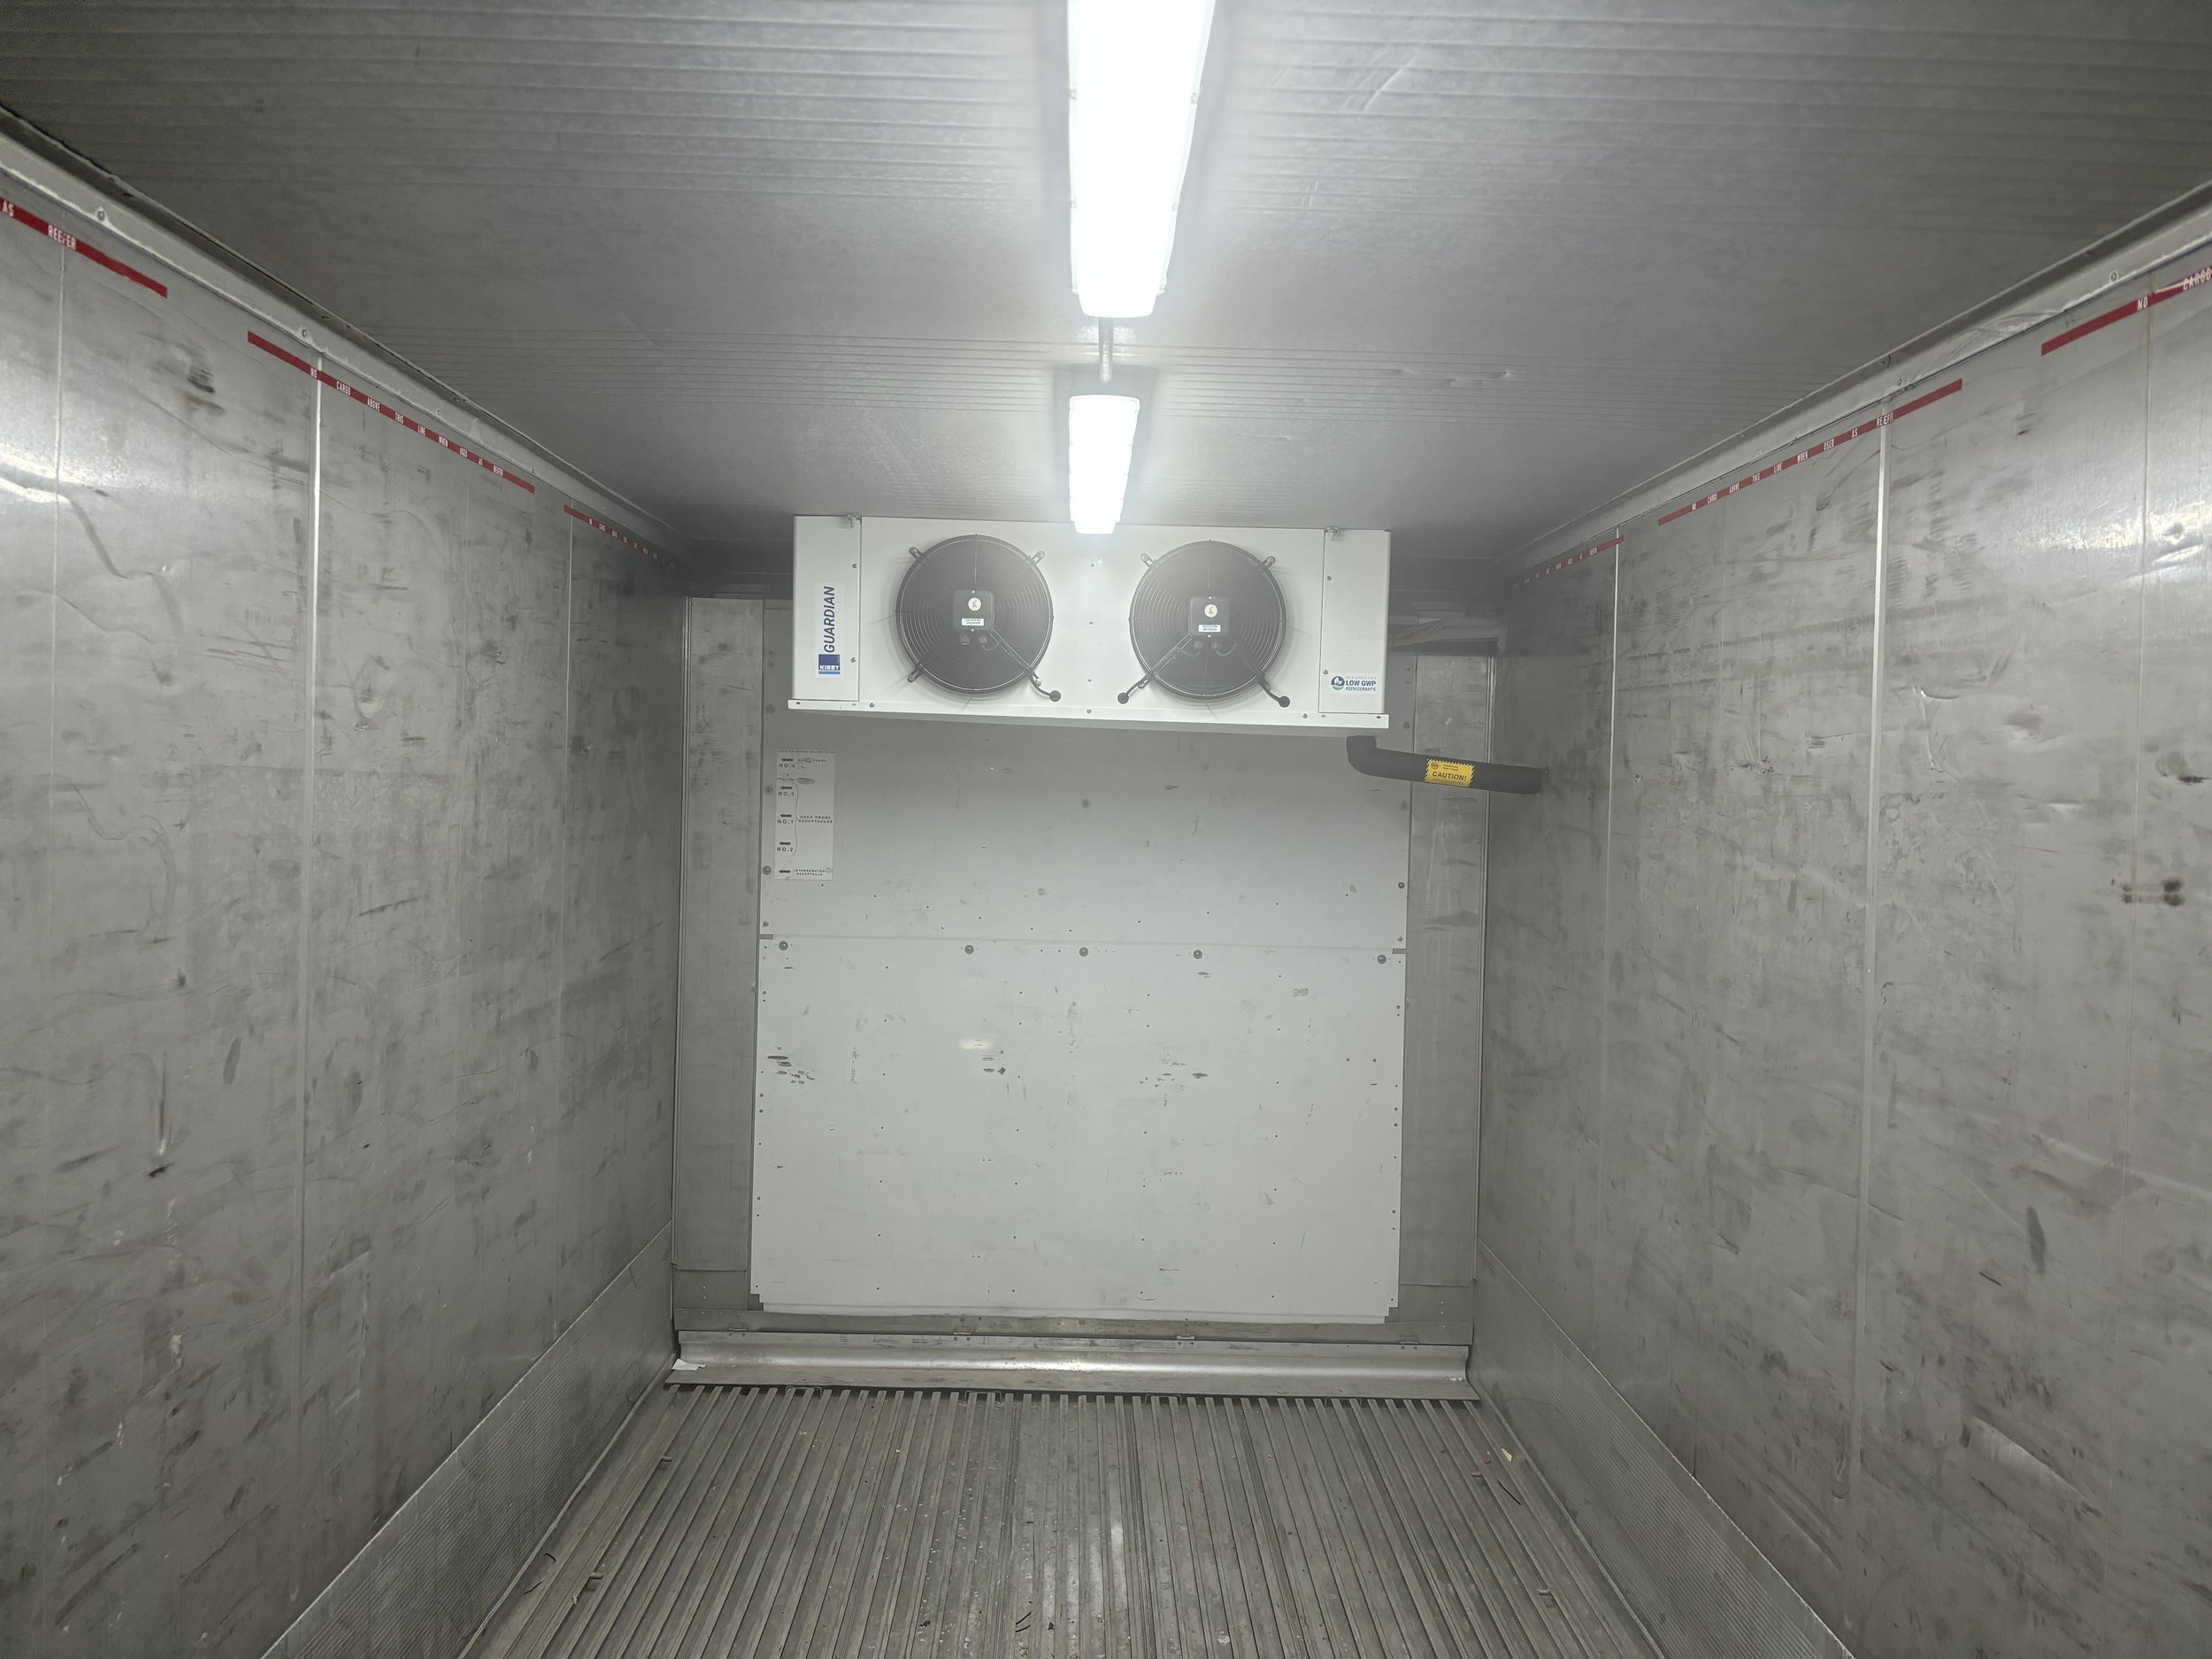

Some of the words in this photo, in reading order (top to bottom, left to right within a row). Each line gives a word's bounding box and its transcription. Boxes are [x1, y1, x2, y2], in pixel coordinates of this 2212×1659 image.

[2, 200, 14, 217] AS
[48, 225, 76, 250] REEFER
[2137, 296, 2148, 311] NO
[2183, 267, 2212, 291] CARGO
[311, 367, 318, 379] NO
[336, 380, 351, 396] CARGO
[367, 397, 380, 412] ABOVE
[395, 412, 404, 425] THIS
[438, 435, 449, 448] WHEN
[1692, 503, 1697, 511] NO
[1707, 493, 1717, 504] CARGO
[1729, 482, 1740, 495] ABOVE
[1752, 472, 1761, 484] THIS
[1773, 462, 1783, 474] LINE
[1797, 450, 1809, 464] WHEN
[1823, 438, 1835, 451] USED
[1851, 427, 1858, 439] AS
[824, 586, 835, 653] GUARDIAN
[1432, 771, 1467, 781] CAUTION!
